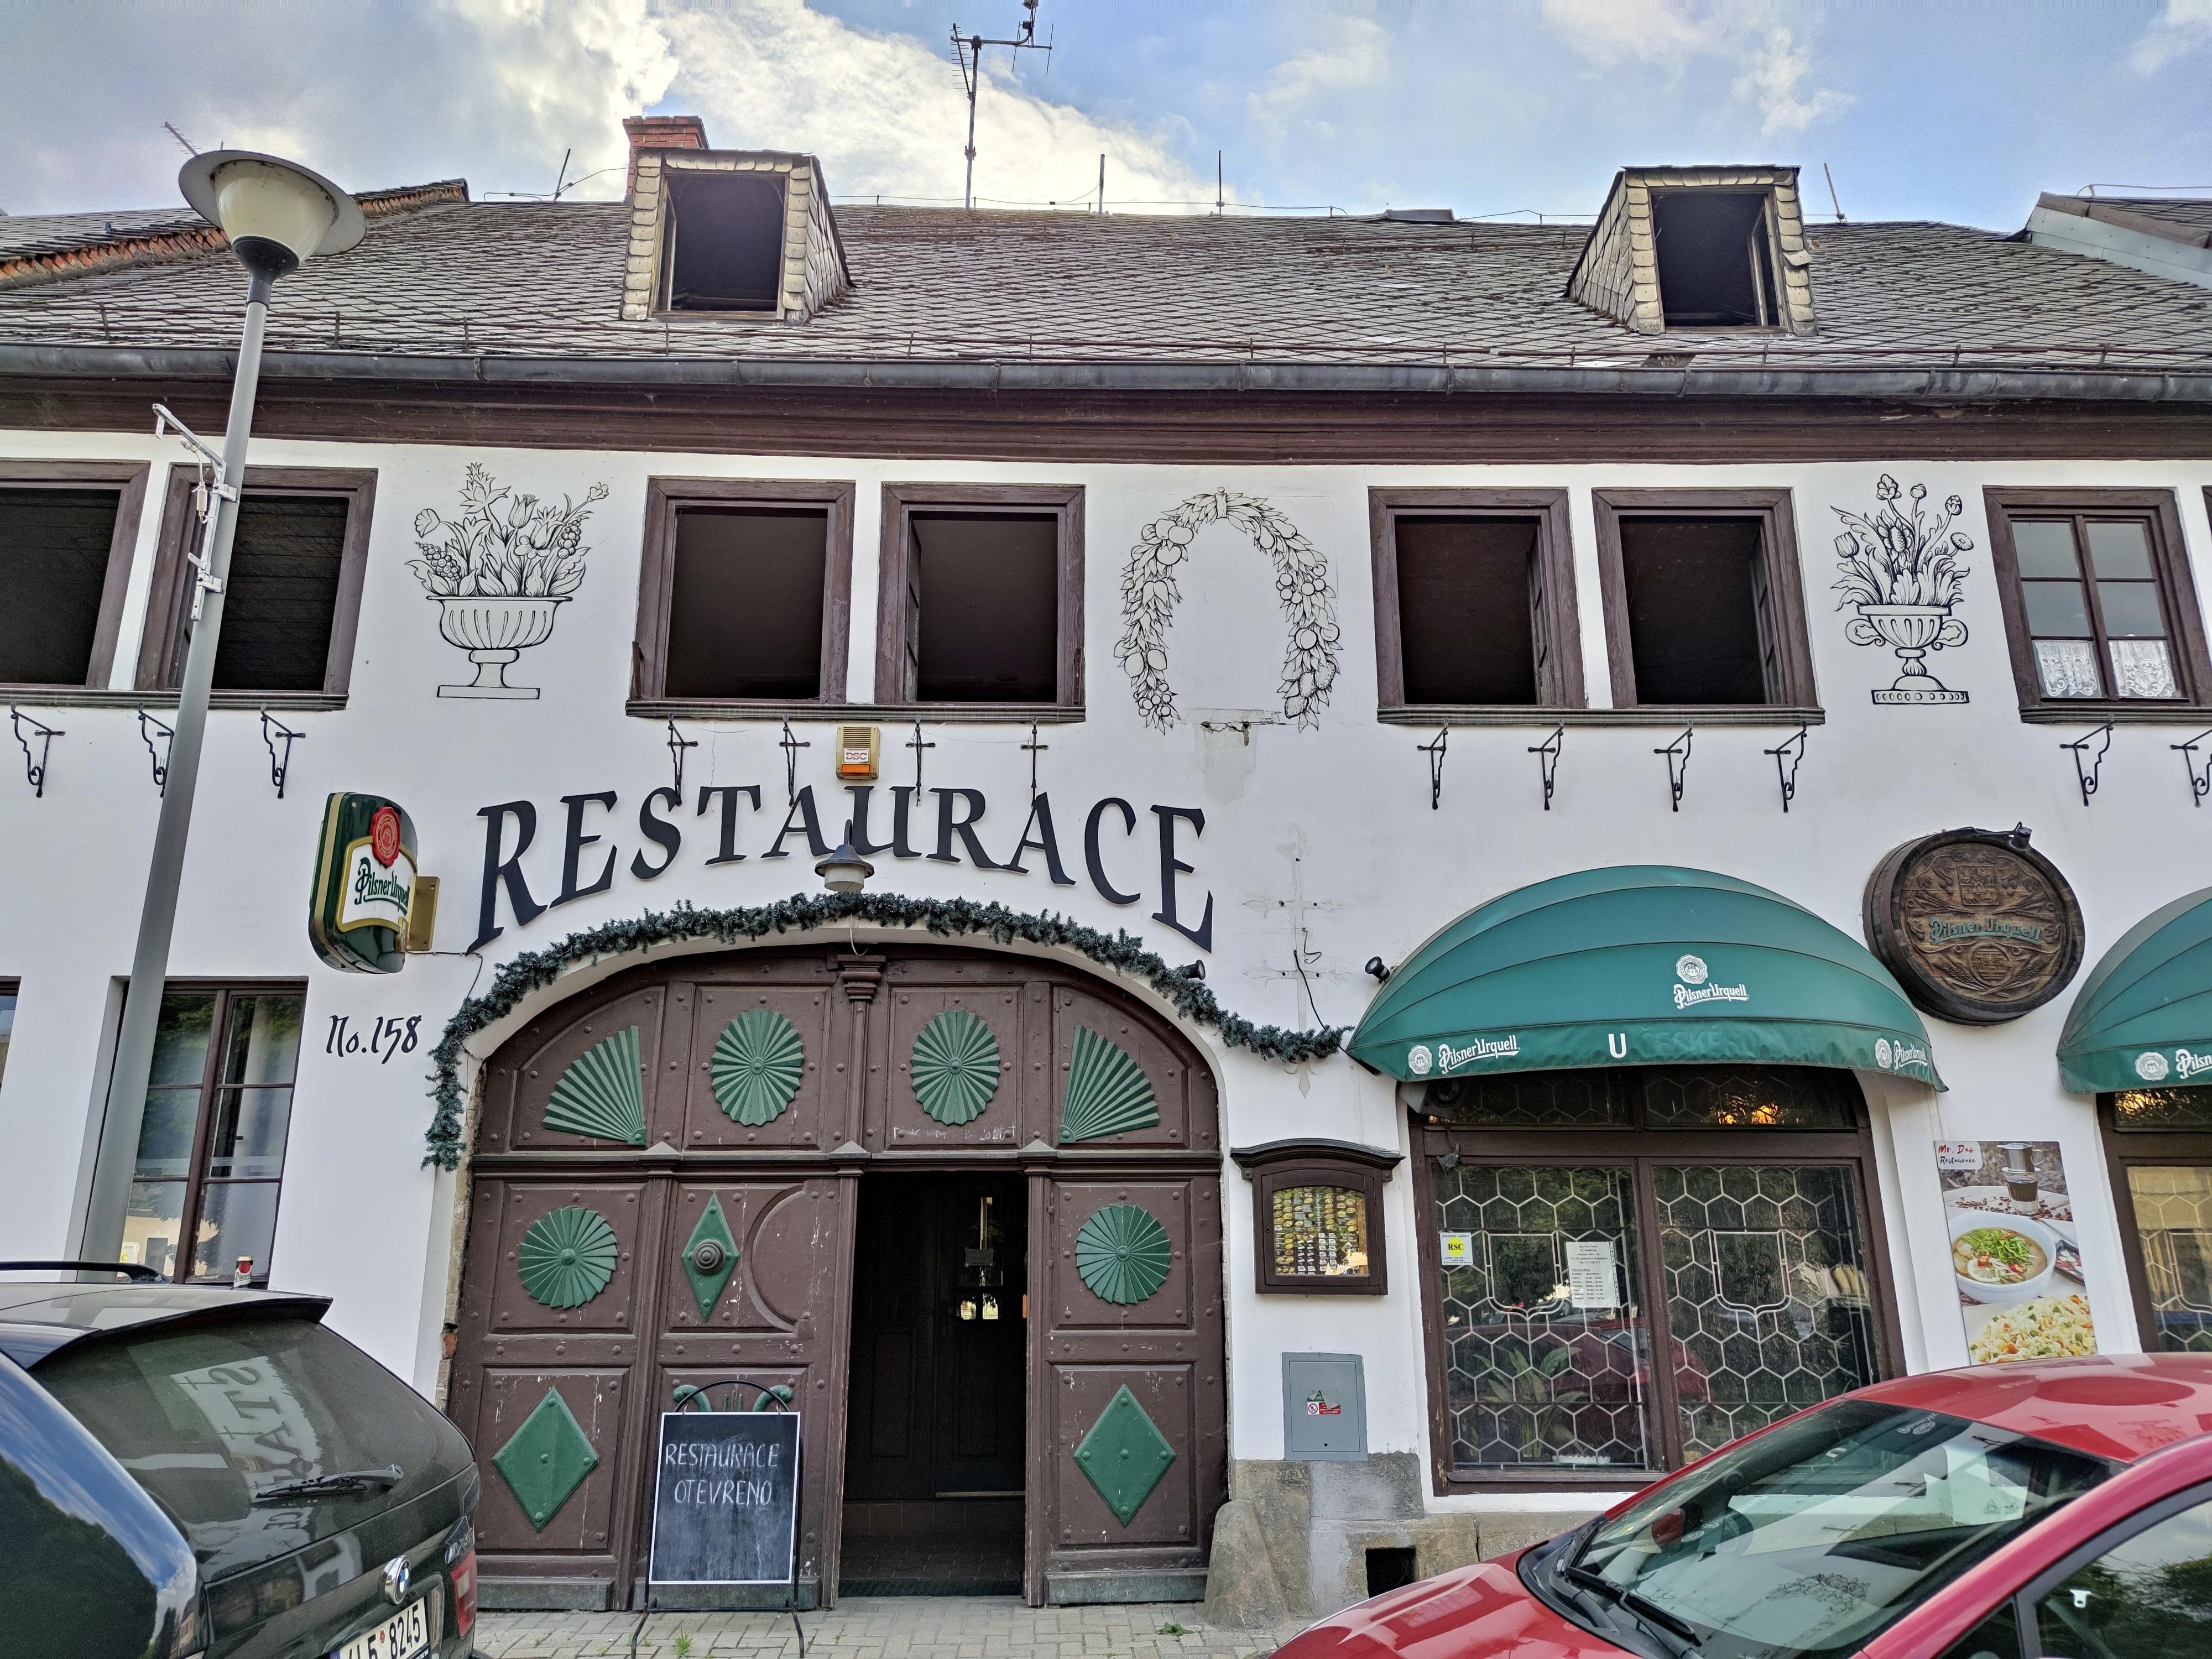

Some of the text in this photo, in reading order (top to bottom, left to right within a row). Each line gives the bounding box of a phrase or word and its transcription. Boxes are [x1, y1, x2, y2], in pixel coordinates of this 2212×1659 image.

[845, 752, 868, 760] DSC
[354, 857, 392, 905] Pilsner
[466, 785, 1213, 953] RESTAURACE
[1929, 916, 2041, 945] Pilsner Urquell
[1673, 982, 1747, 1010] Pilsner Urquell
[1438, 1044, 1477, 1074] Pilsner
[1474, 1035, 1517, 1059] Urquell
[1608, 1033, 1627, 1058] U
[1893, 1040, 1913, 1070] Pilsner
[2175, 1048, 2212, 1079] Pilsn
[1938, 1144, 1974, 1154] Mr. Dao
[1940, 1156, 1976, 1165] Restaurace
[665, 1443, 780, 1467] RESTAURACE
[389, 1604, 420, 1659] 8245
